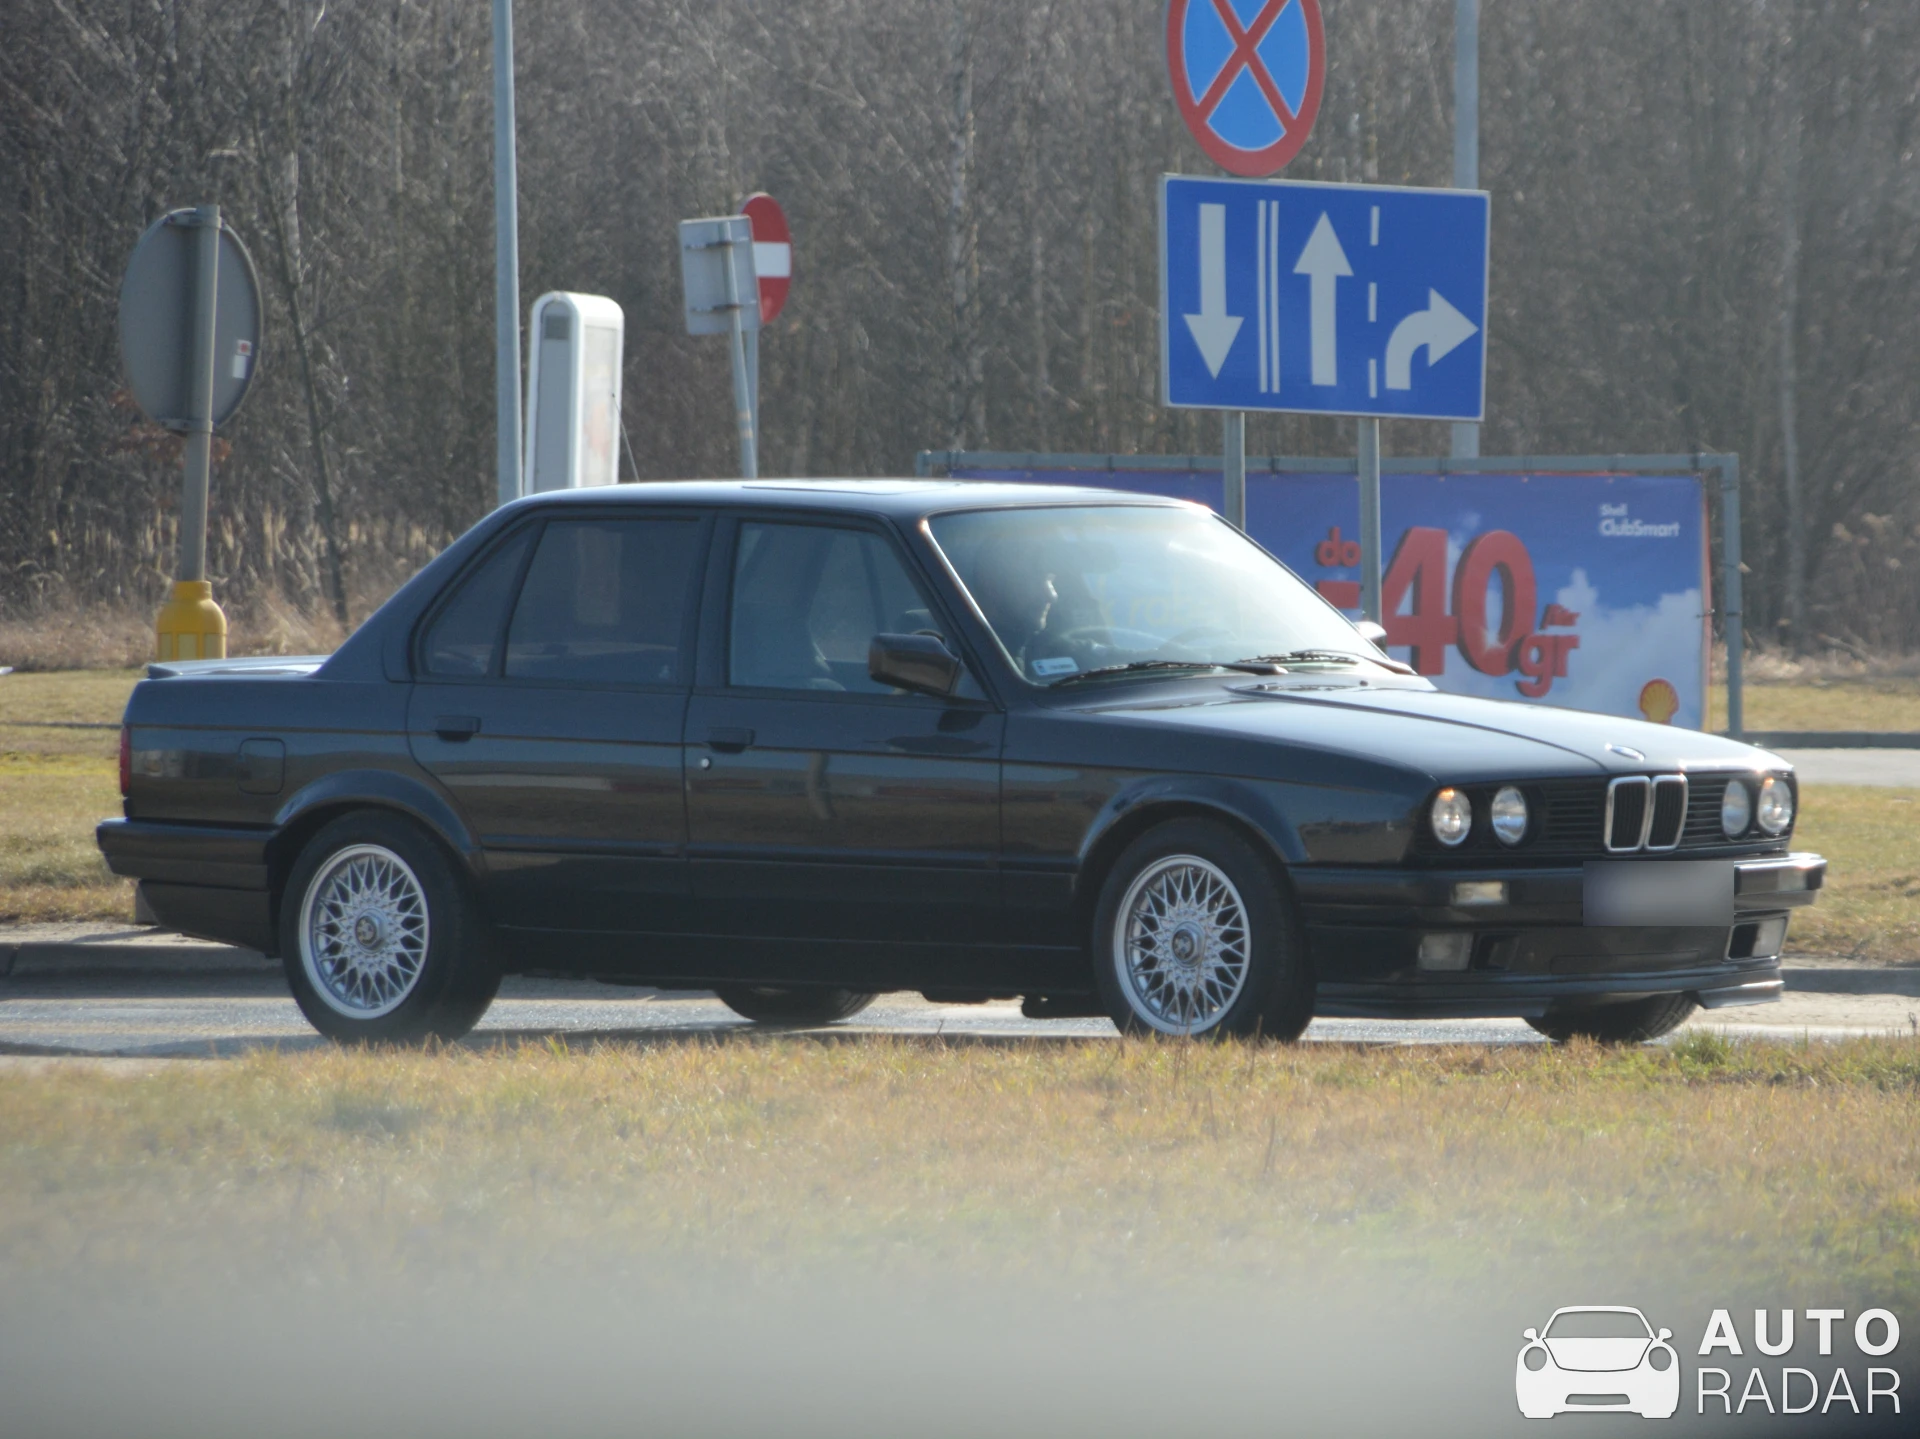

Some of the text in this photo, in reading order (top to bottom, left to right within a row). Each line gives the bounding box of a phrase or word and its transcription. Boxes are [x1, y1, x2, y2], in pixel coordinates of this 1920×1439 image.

[1314, 526, 1362, 568] do
[1600, 519, 1680, 537] ClubSmart
[1515, 634, 1581, 698] gr
